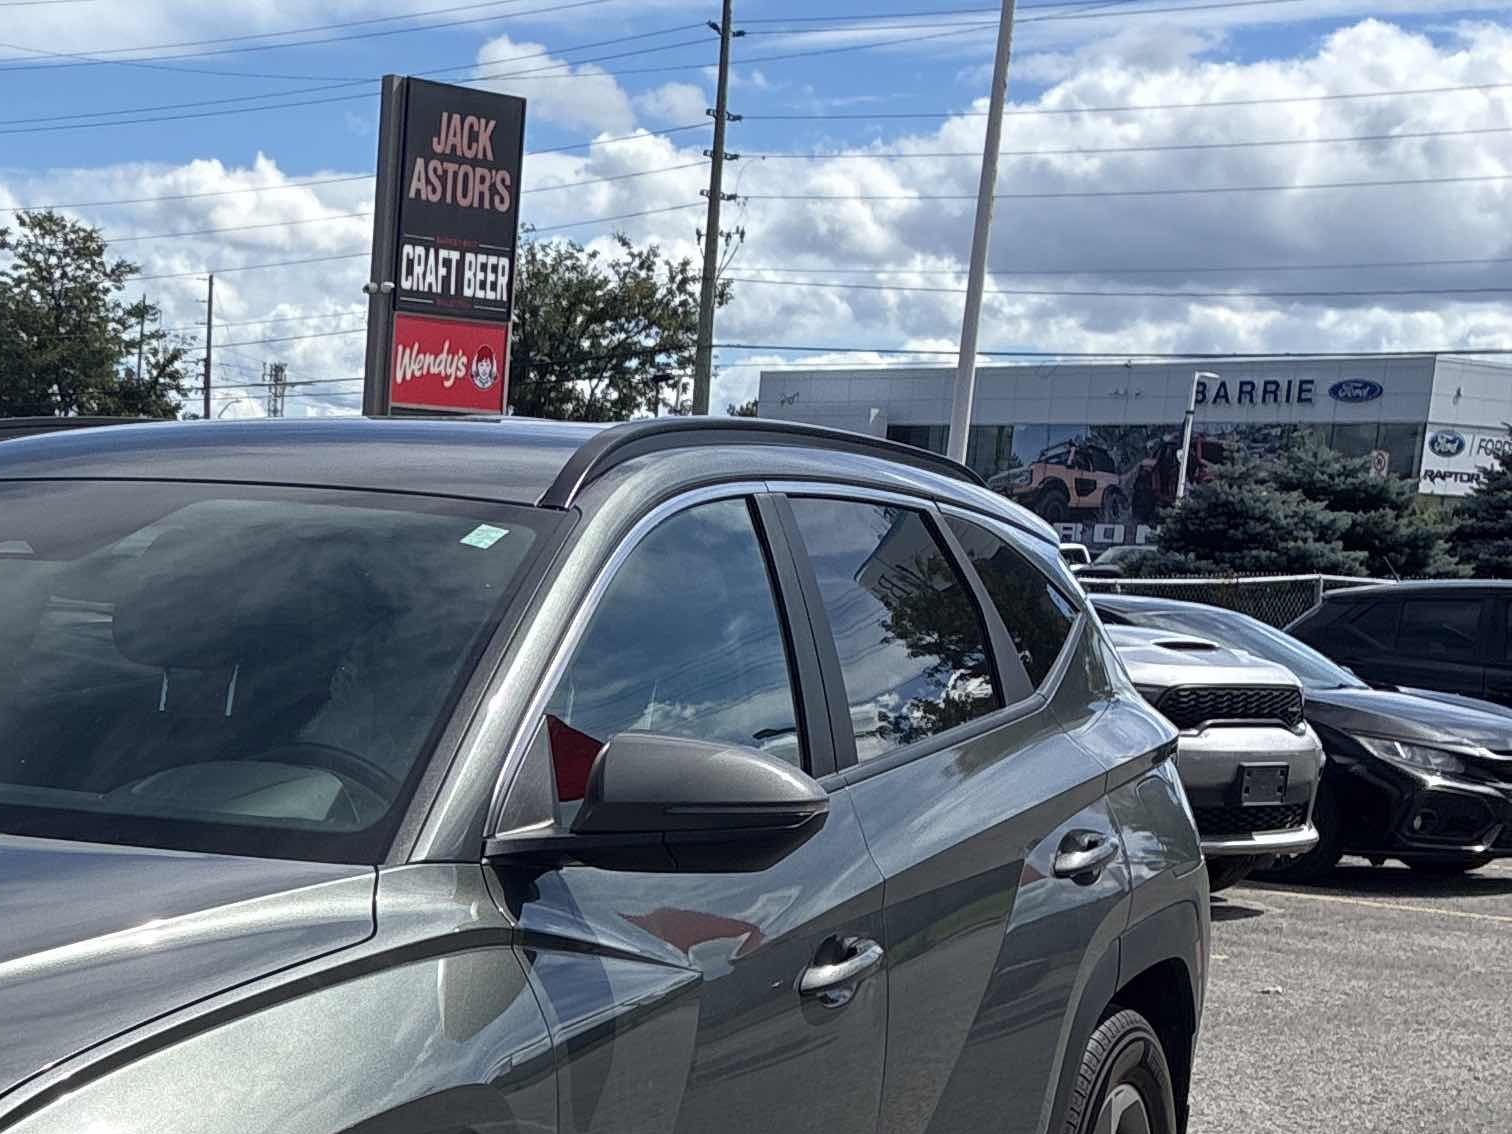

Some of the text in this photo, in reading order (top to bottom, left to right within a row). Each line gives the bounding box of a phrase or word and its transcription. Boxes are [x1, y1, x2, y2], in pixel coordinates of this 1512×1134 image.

[432, 111, 497, 160] JACK
[409, 157, 512, 212] ASTOR'S
[400, 243, 510, 302] CRAFT BEER
[395, 339, 468, 388] Wendy's
[1195, 379, 1315, 404] BARRIE
